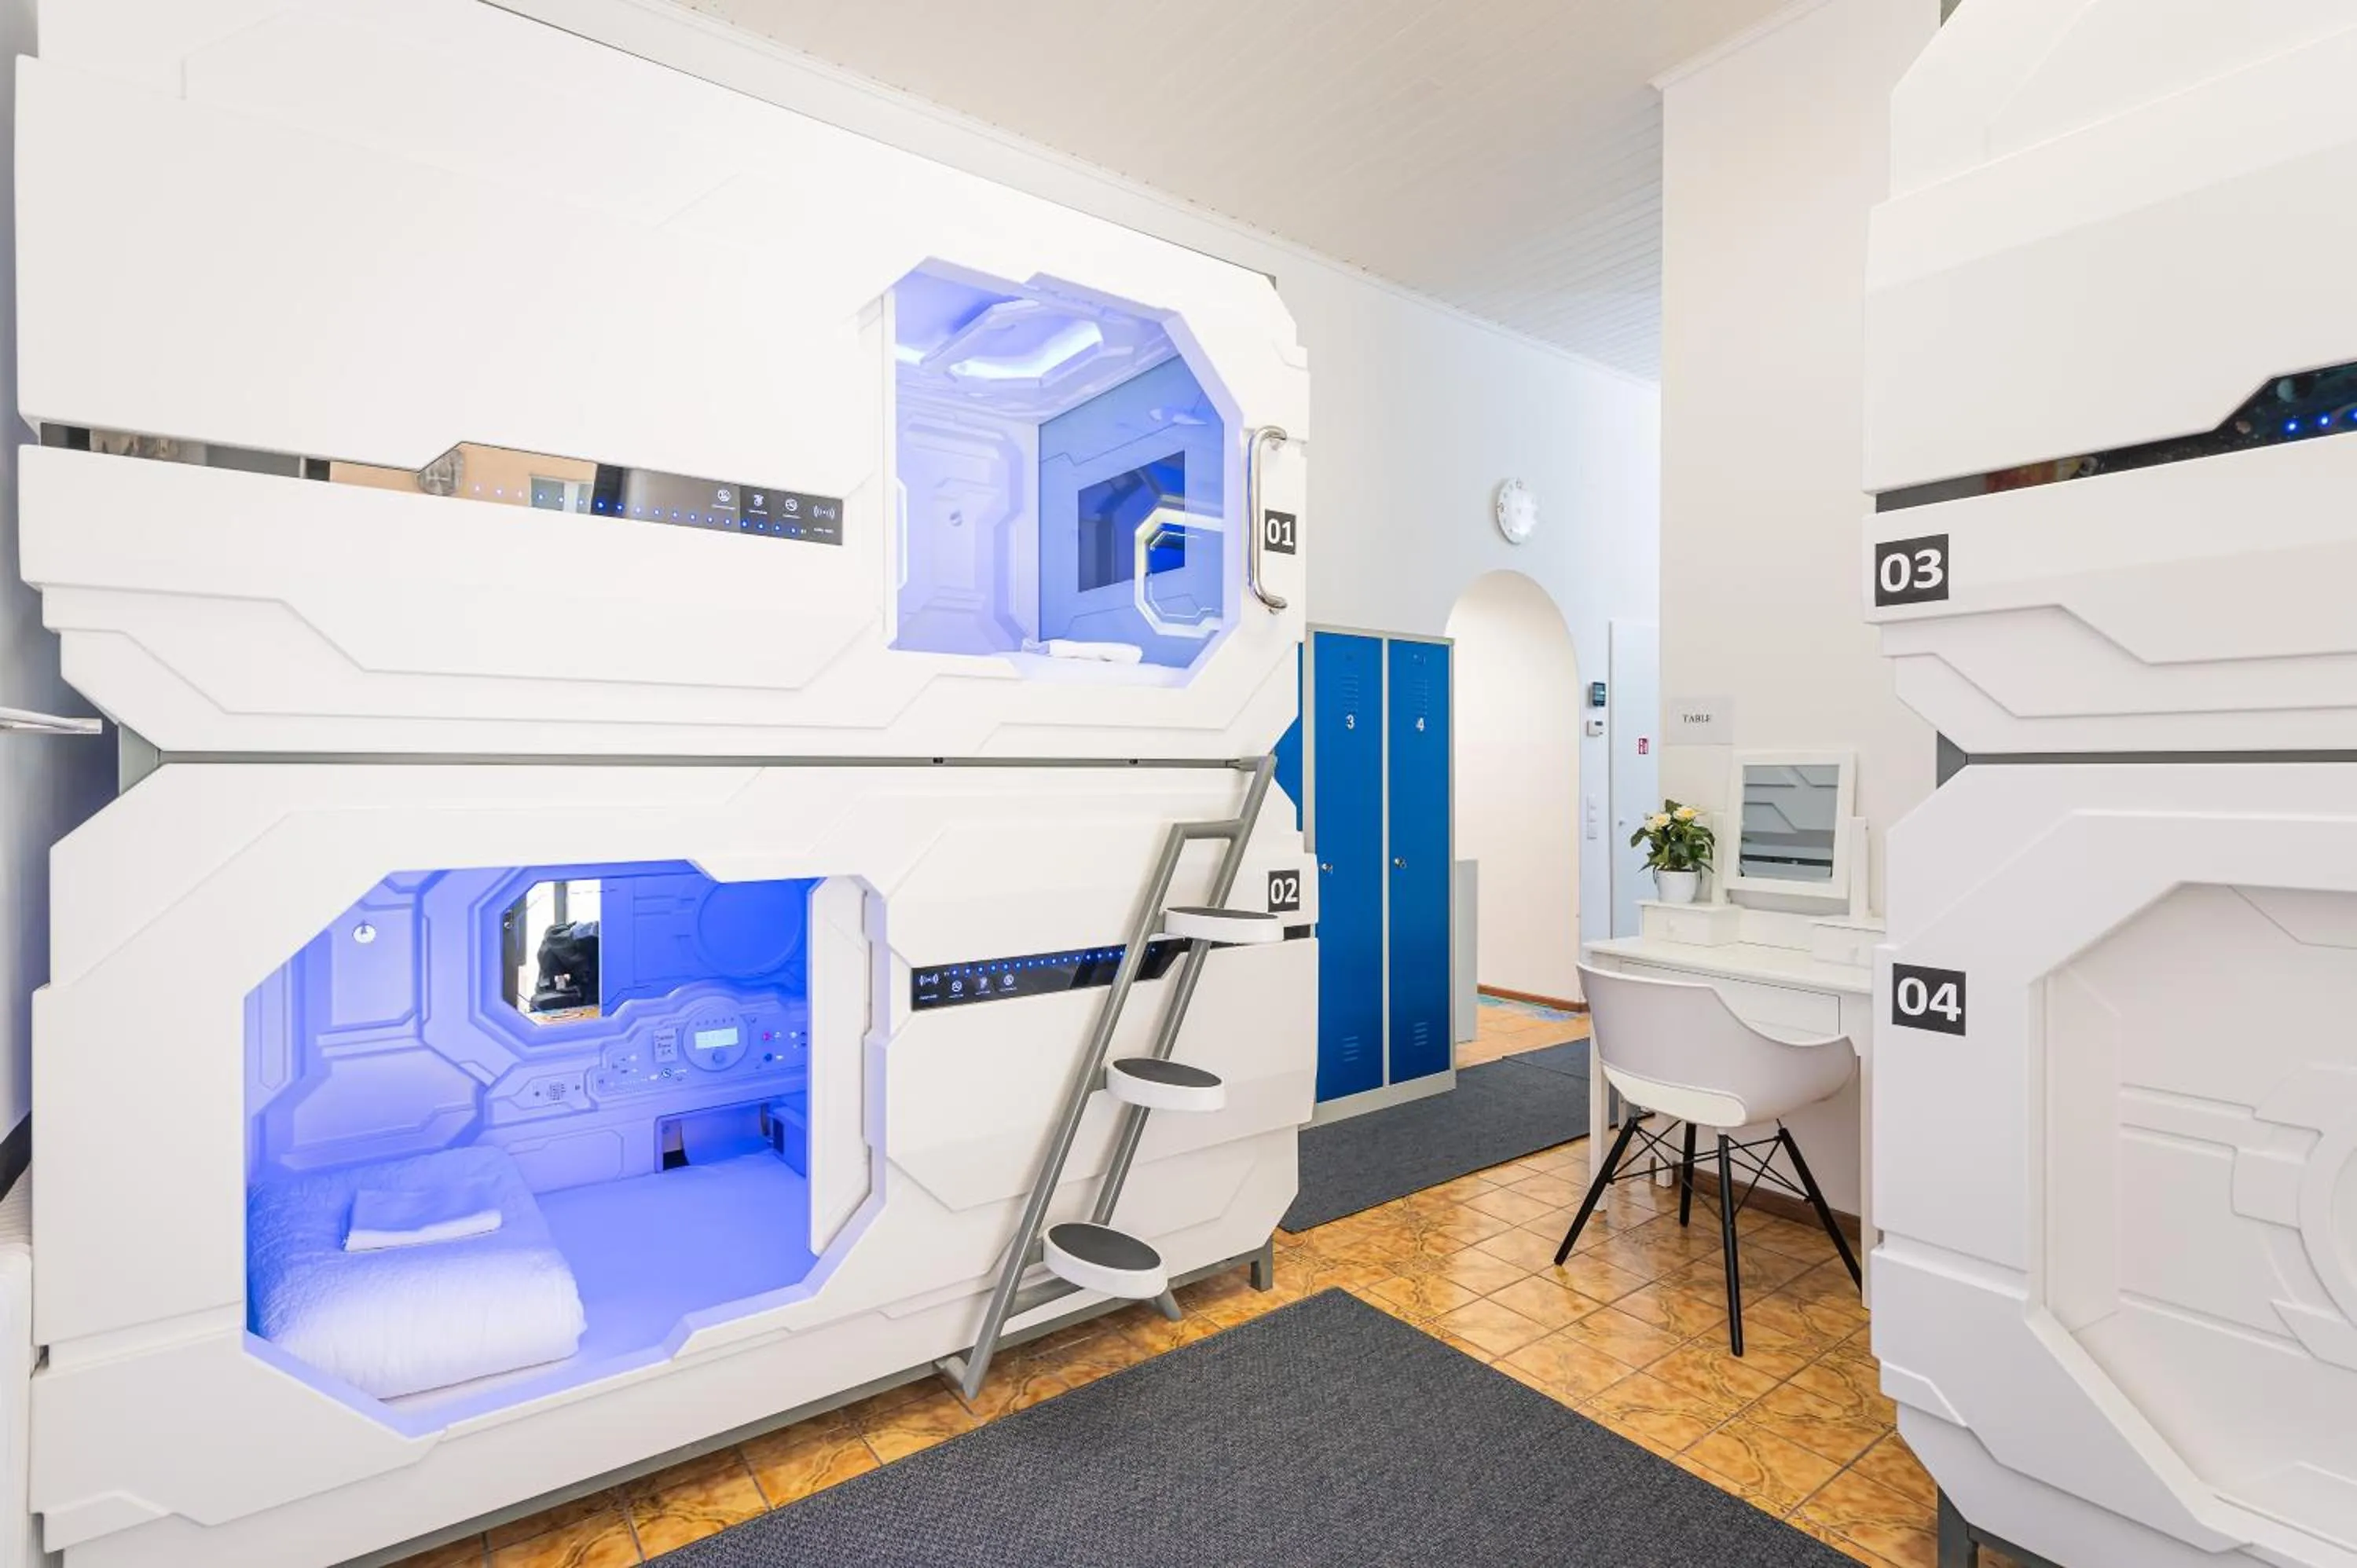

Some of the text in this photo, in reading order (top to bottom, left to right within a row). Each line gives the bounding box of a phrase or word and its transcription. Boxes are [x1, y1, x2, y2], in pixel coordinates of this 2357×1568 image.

[1266, 518, 1294, 546] 01
[1880, 548, 1943, 593] 03
[1345, 714, 1356, 729] 3
[1416, 717, 1425, 731] 4
[1682, 713, 1711, 724] TABLE
[1270, 877, 1299, 904] 02
[1897, 976, 1962, 1022] 04
